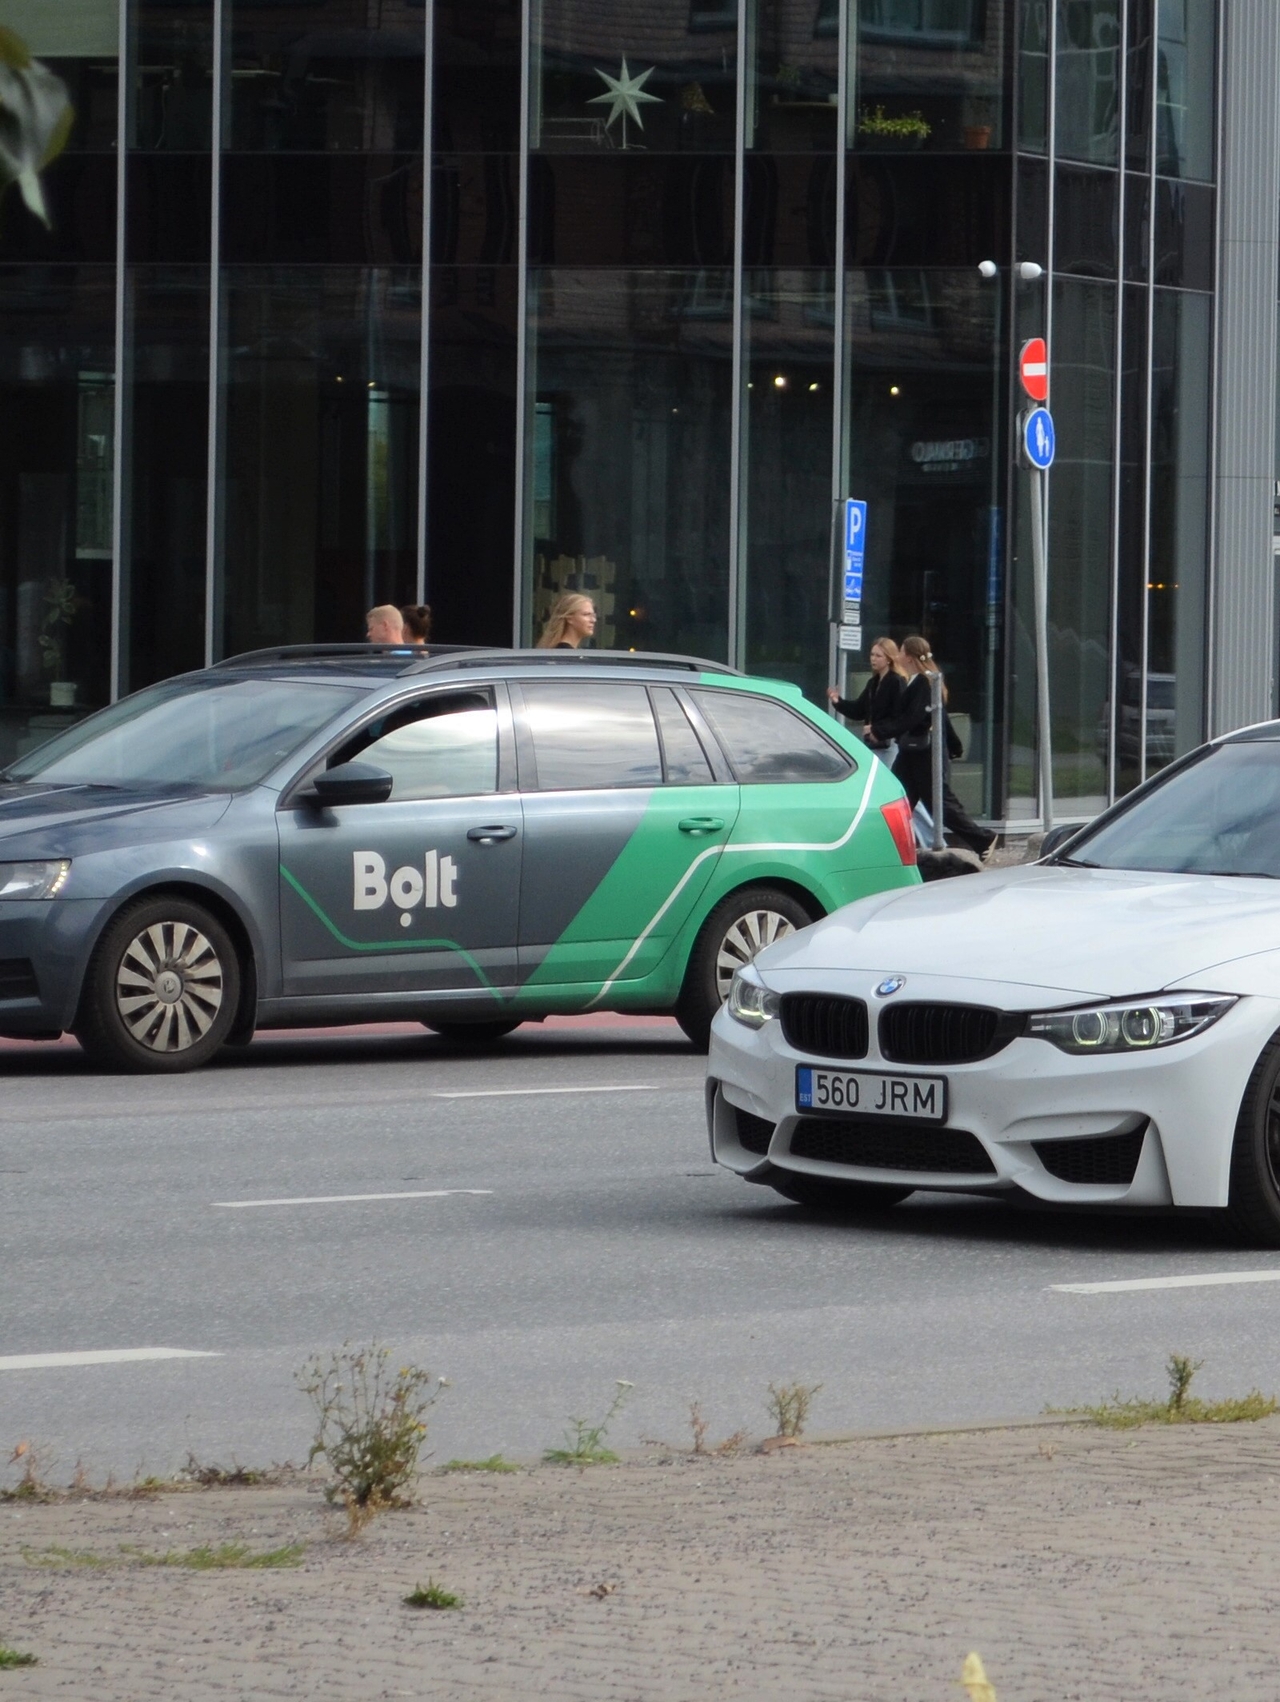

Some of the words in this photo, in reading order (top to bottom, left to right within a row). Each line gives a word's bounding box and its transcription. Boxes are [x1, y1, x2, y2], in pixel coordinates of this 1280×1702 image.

[850, 507, 862, 545] P
[353, 848, 458, 928] Bolt
[800, 1092, 812, 1102] EST
[817, 1074, 860, 1108] 560
[874, 1079, 936, 1114] JRM
